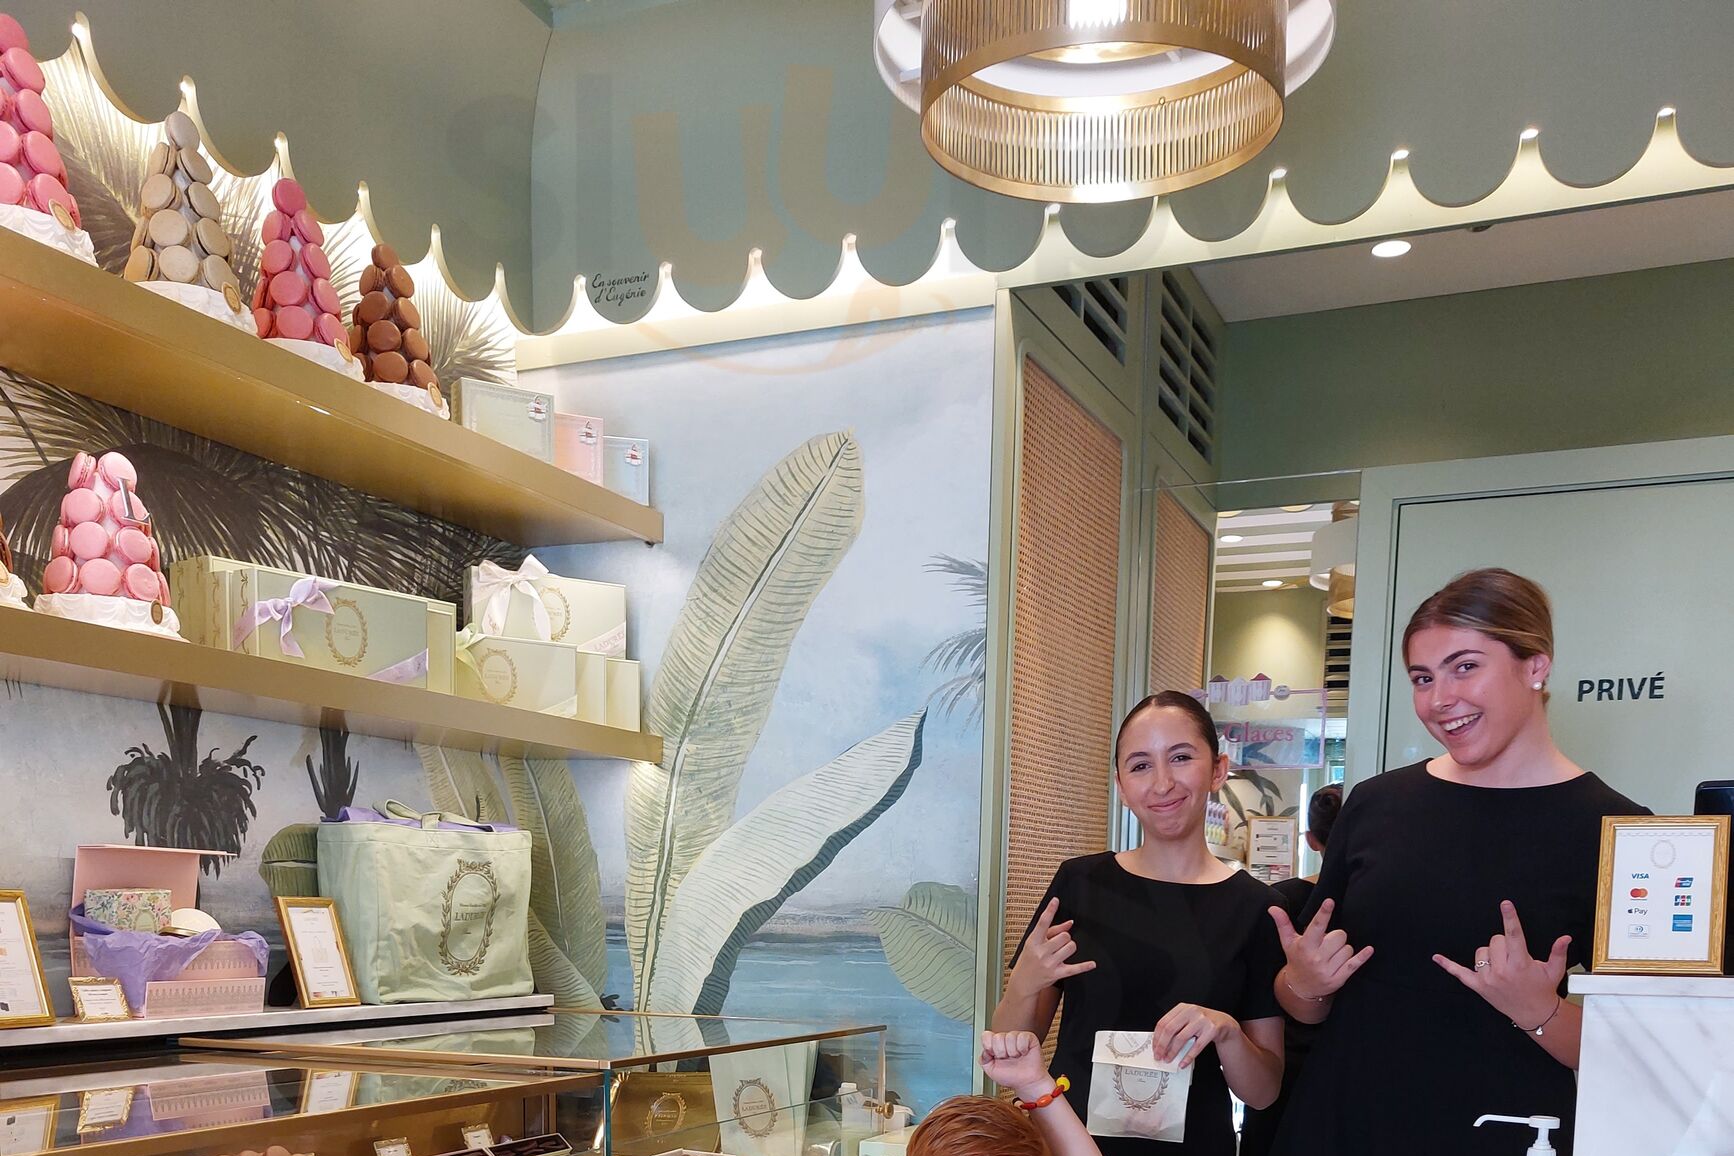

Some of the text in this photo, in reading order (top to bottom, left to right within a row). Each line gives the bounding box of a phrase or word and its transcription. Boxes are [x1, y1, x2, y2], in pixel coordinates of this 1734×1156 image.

[591, 271, 650, 289] En souvenir
[1577, 671, 1665, 702] PRIVÉ
[1223, 721, 1295, 744] Glaces
[1634, 907, 1649, 916] Pay
